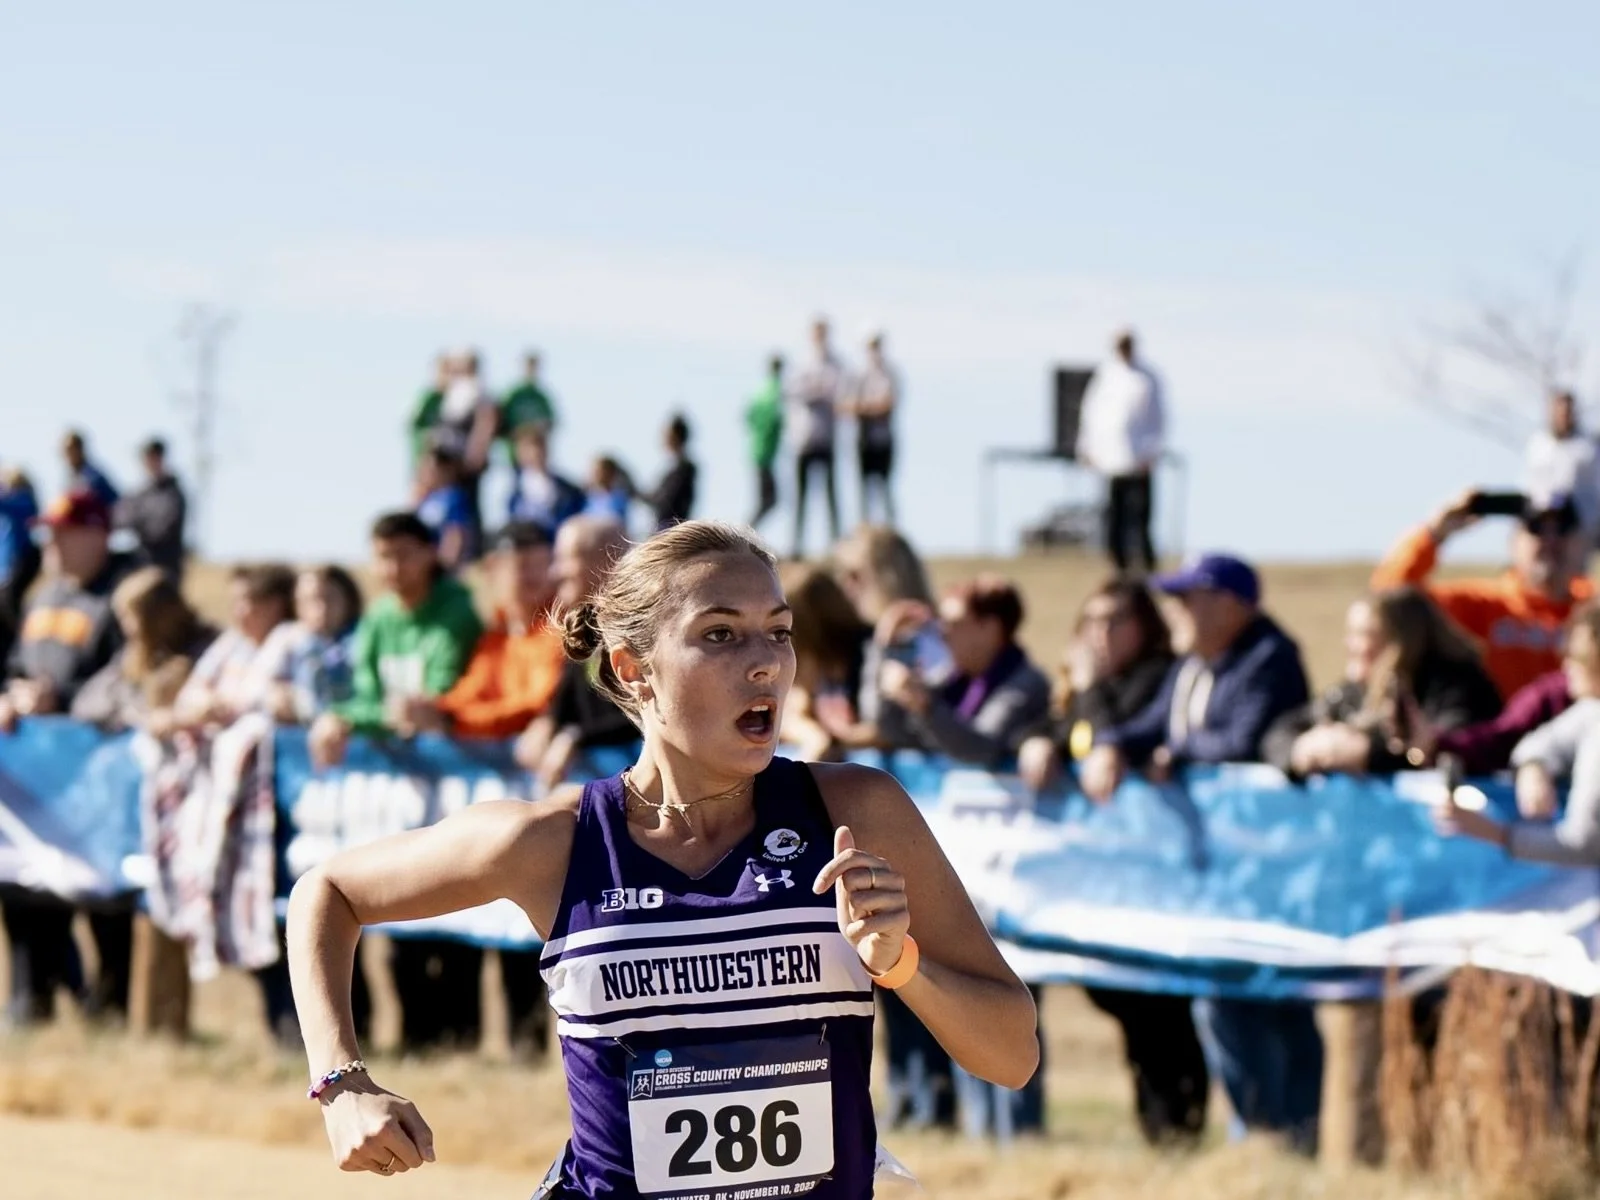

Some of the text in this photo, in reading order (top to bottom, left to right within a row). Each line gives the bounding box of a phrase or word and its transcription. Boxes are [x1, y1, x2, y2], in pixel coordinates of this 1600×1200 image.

[599, 943, 821, 1002] NORTHWESTERN
[655, 1072, 691, 1086] CROSS
[693, 1067, 742, 1083] COUNTRY
[744, 1058, 829, 1078] CHAMPIONSHIPS
[664, 1099, 802, 1178] 286
[734, 1186, 779, 1200] NOVEMBER
[780, 1184, 792, 1195] 10,
